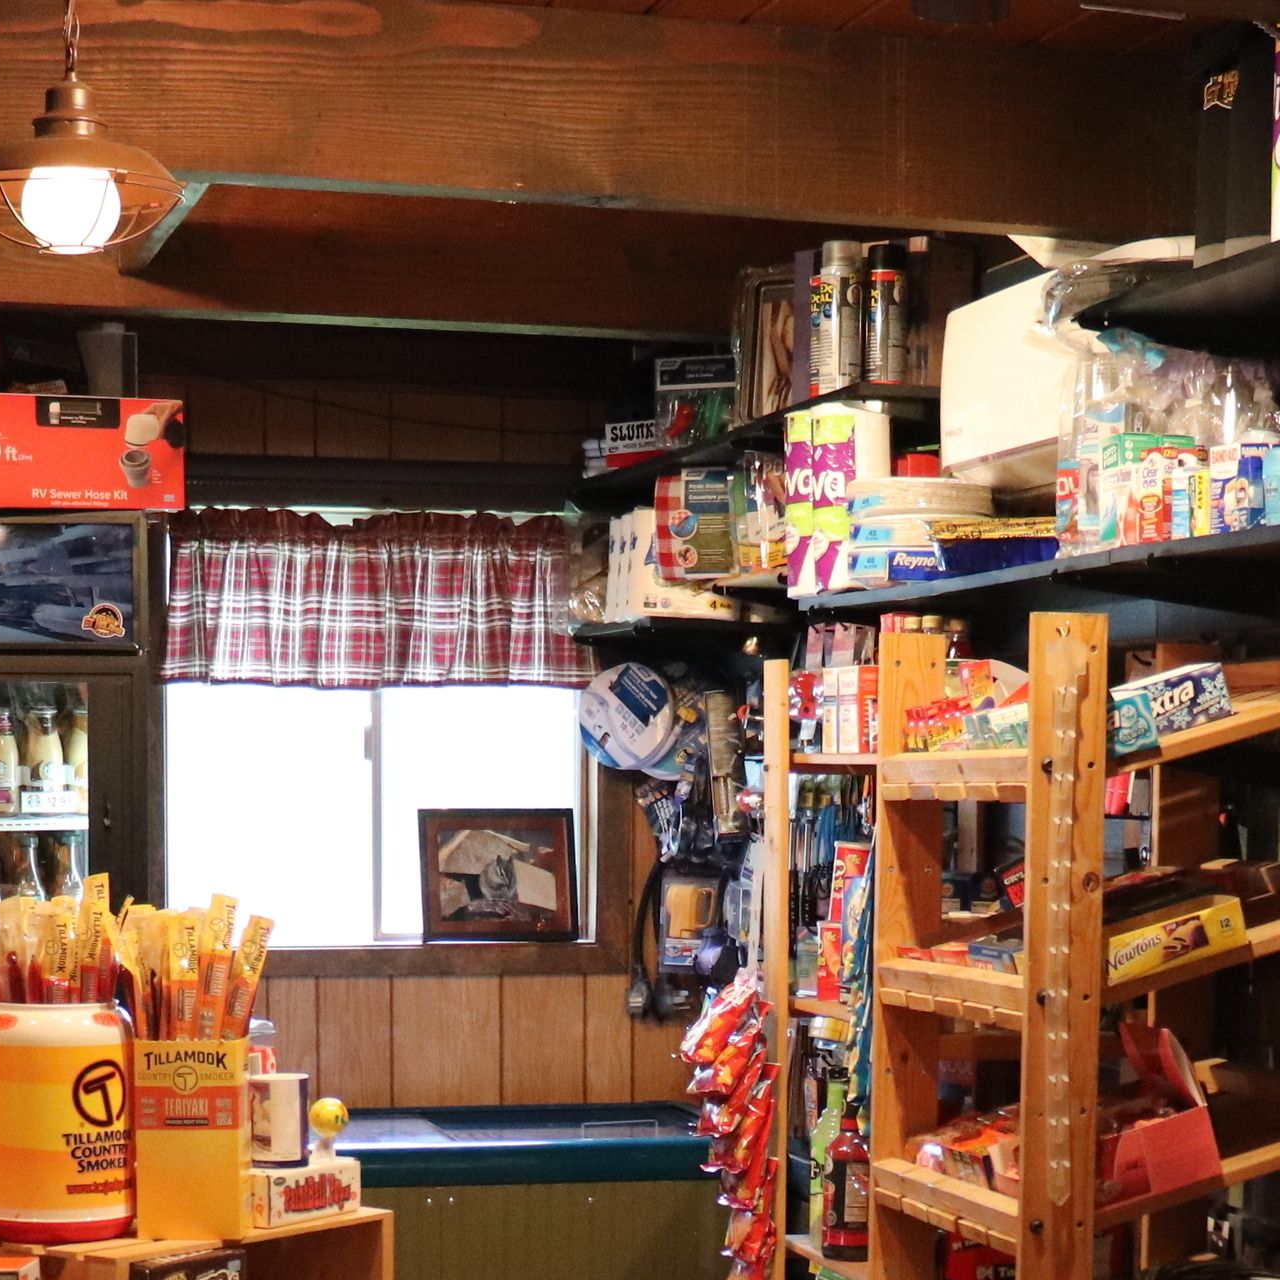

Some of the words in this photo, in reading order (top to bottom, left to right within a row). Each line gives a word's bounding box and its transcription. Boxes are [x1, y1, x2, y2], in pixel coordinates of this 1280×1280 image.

[4, 440, 18, 462] ft
[1142, 468, 1158, 478] Clear
[32, 488, 48, 499] RV
[50, 488, 82, 500] Sewer
[85, 488, 111, 500] Hose
[113, 488, 128, 501] Kit
[223, 904, 236, 950] TILLAMOOK
[1220, 917, 1231, 929] 12
[89, 911, 103, 961] TILLAMOOK
[55, 922, 68, 974] TILLAMOOK
[184, 925, 197, 974] TILLAMOOK
[250, 926, 271, 974] TILLAMOOK
[1106, 934, 1162, 978] Newtons
[143, 1050, 228, 1072] TILLAMOOK
[137, 1071, 172, 1082] COUNTRY
[199, 1071, 236, 1082] SMOKER
[163, 1097, 209, 1118] TERIYAKI
